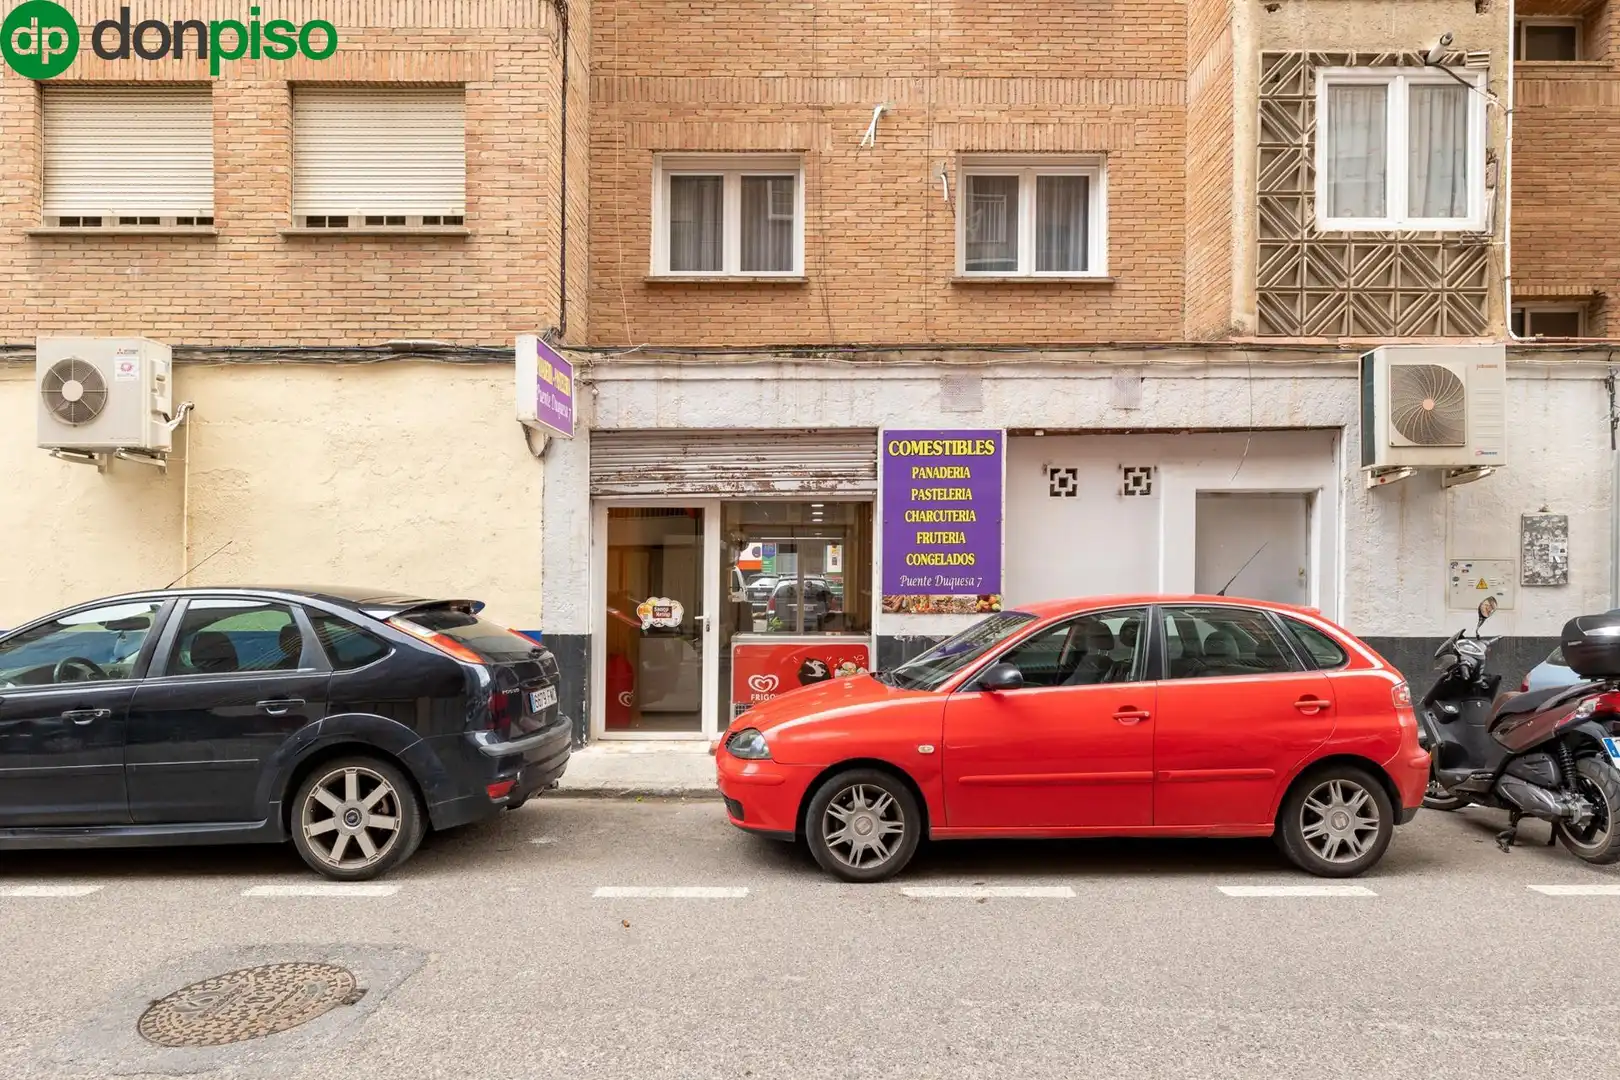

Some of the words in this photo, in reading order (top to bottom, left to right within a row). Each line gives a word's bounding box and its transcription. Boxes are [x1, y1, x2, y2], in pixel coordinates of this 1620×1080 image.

[888, 439, 995, 456] COMESTIBLES
[911, 466, 971, 479] PANADERIA
[911, 488, 972, 501] PASTELERIA
[904, 510, 976, 522] CHARCUTERIA
[916, 531, 966, 544] FRUTERIA
[906, 553, 975, 566] CONGELADOS
[899, 574, 932, 587] Puente
[934, 574, 975, 590] Duquesa
[976, 578, 983, 588] 7
[750, 693, 776, 701] FRIGO
